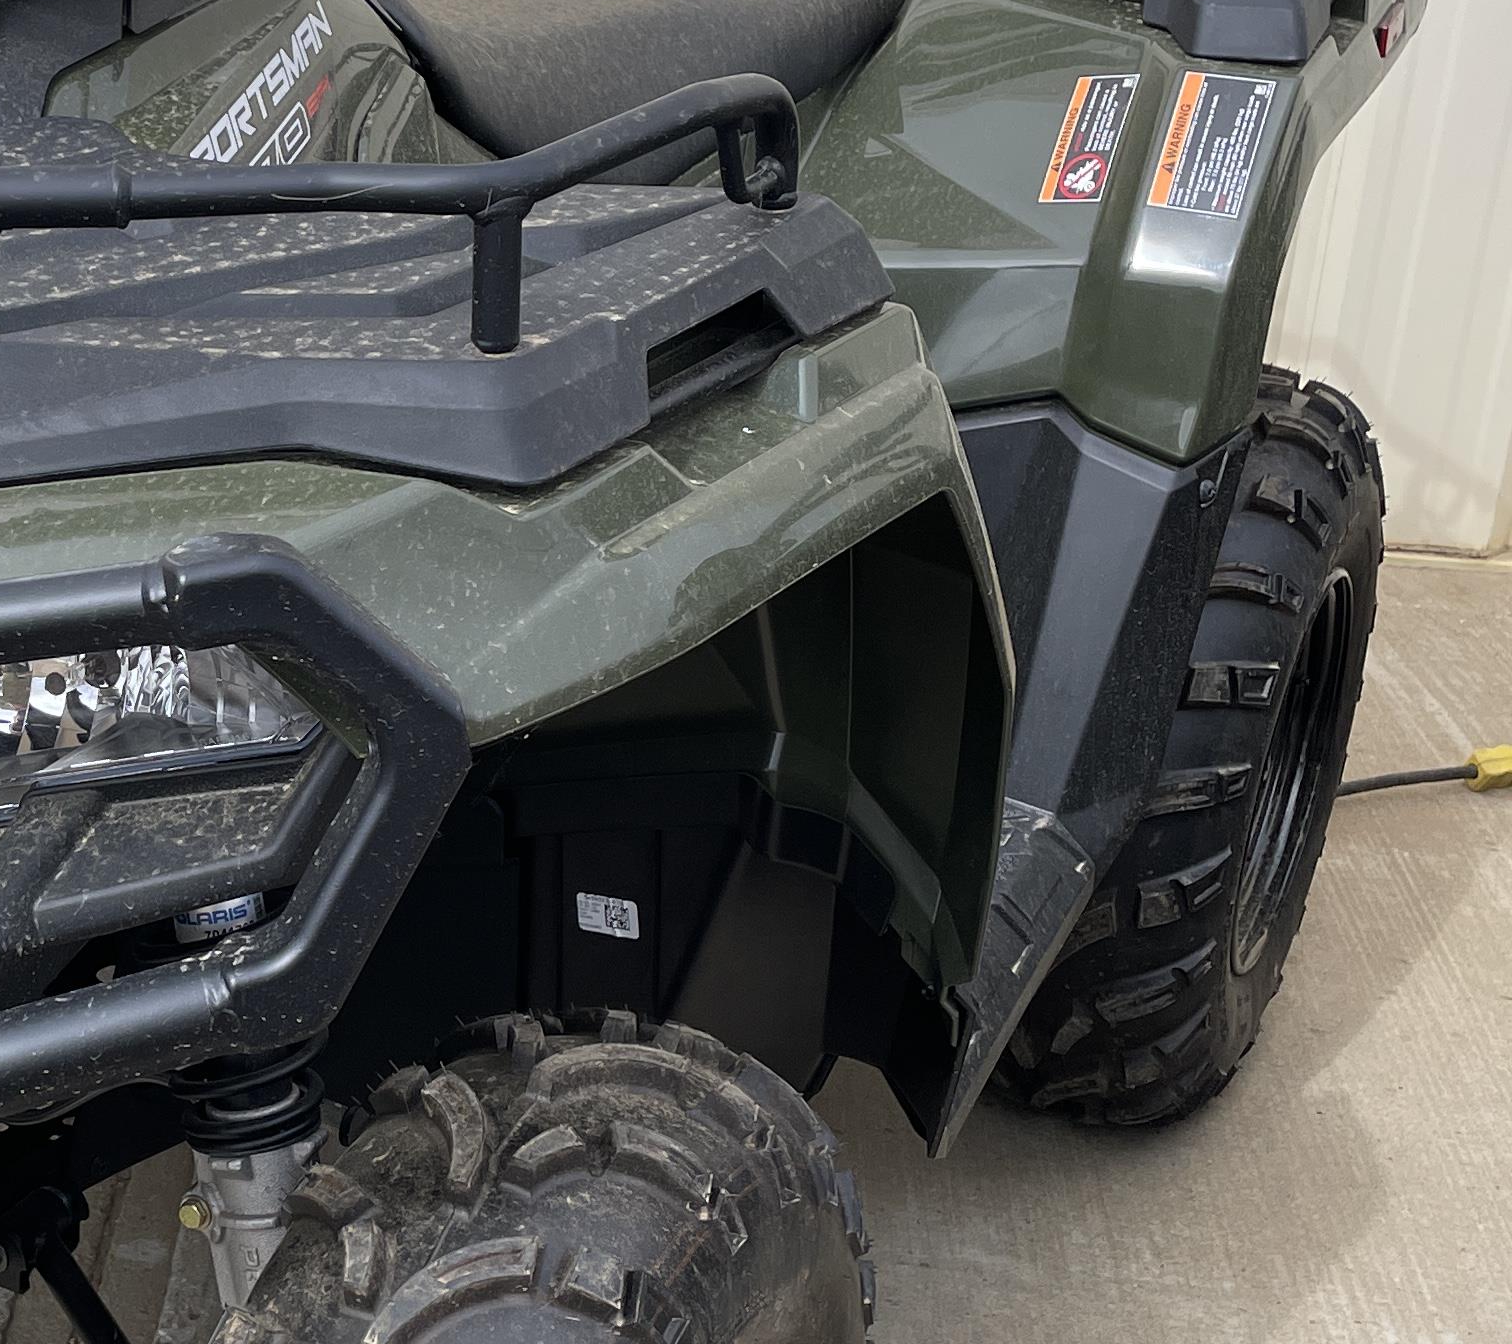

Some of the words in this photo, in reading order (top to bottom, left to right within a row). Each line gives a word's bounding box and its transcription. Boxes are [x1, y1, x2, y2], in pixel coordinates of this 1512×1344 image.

[189, 0, 333, 163] PORTSMAN
[249, 101, 311, 166] 70
[1053, 106, 1079, 161] WARNING
[1167, 102, 1192, 159] WARNING
[175, 903, 248, 926] OLARIS
